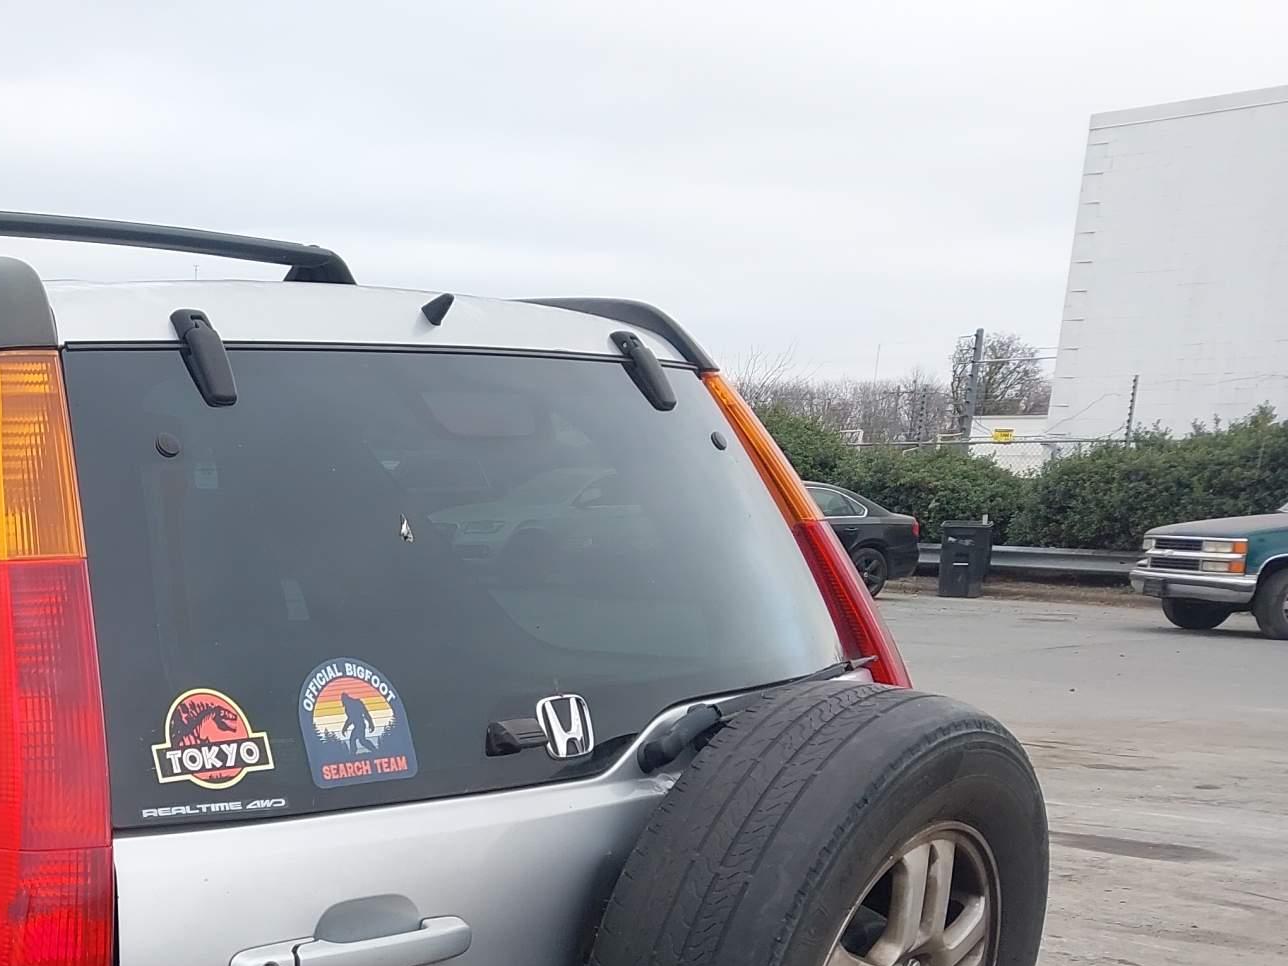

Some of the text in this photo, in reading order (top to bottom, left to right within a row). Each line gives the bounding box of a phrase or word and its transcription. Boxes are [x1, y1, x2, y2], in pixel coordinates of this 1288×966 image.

[303, 662, 397, 712] OFFICIAL BIGFOOT
[166, 741, 260, 774] TOKYO
[321, 755, 409, 780] SEARCH TEAM
